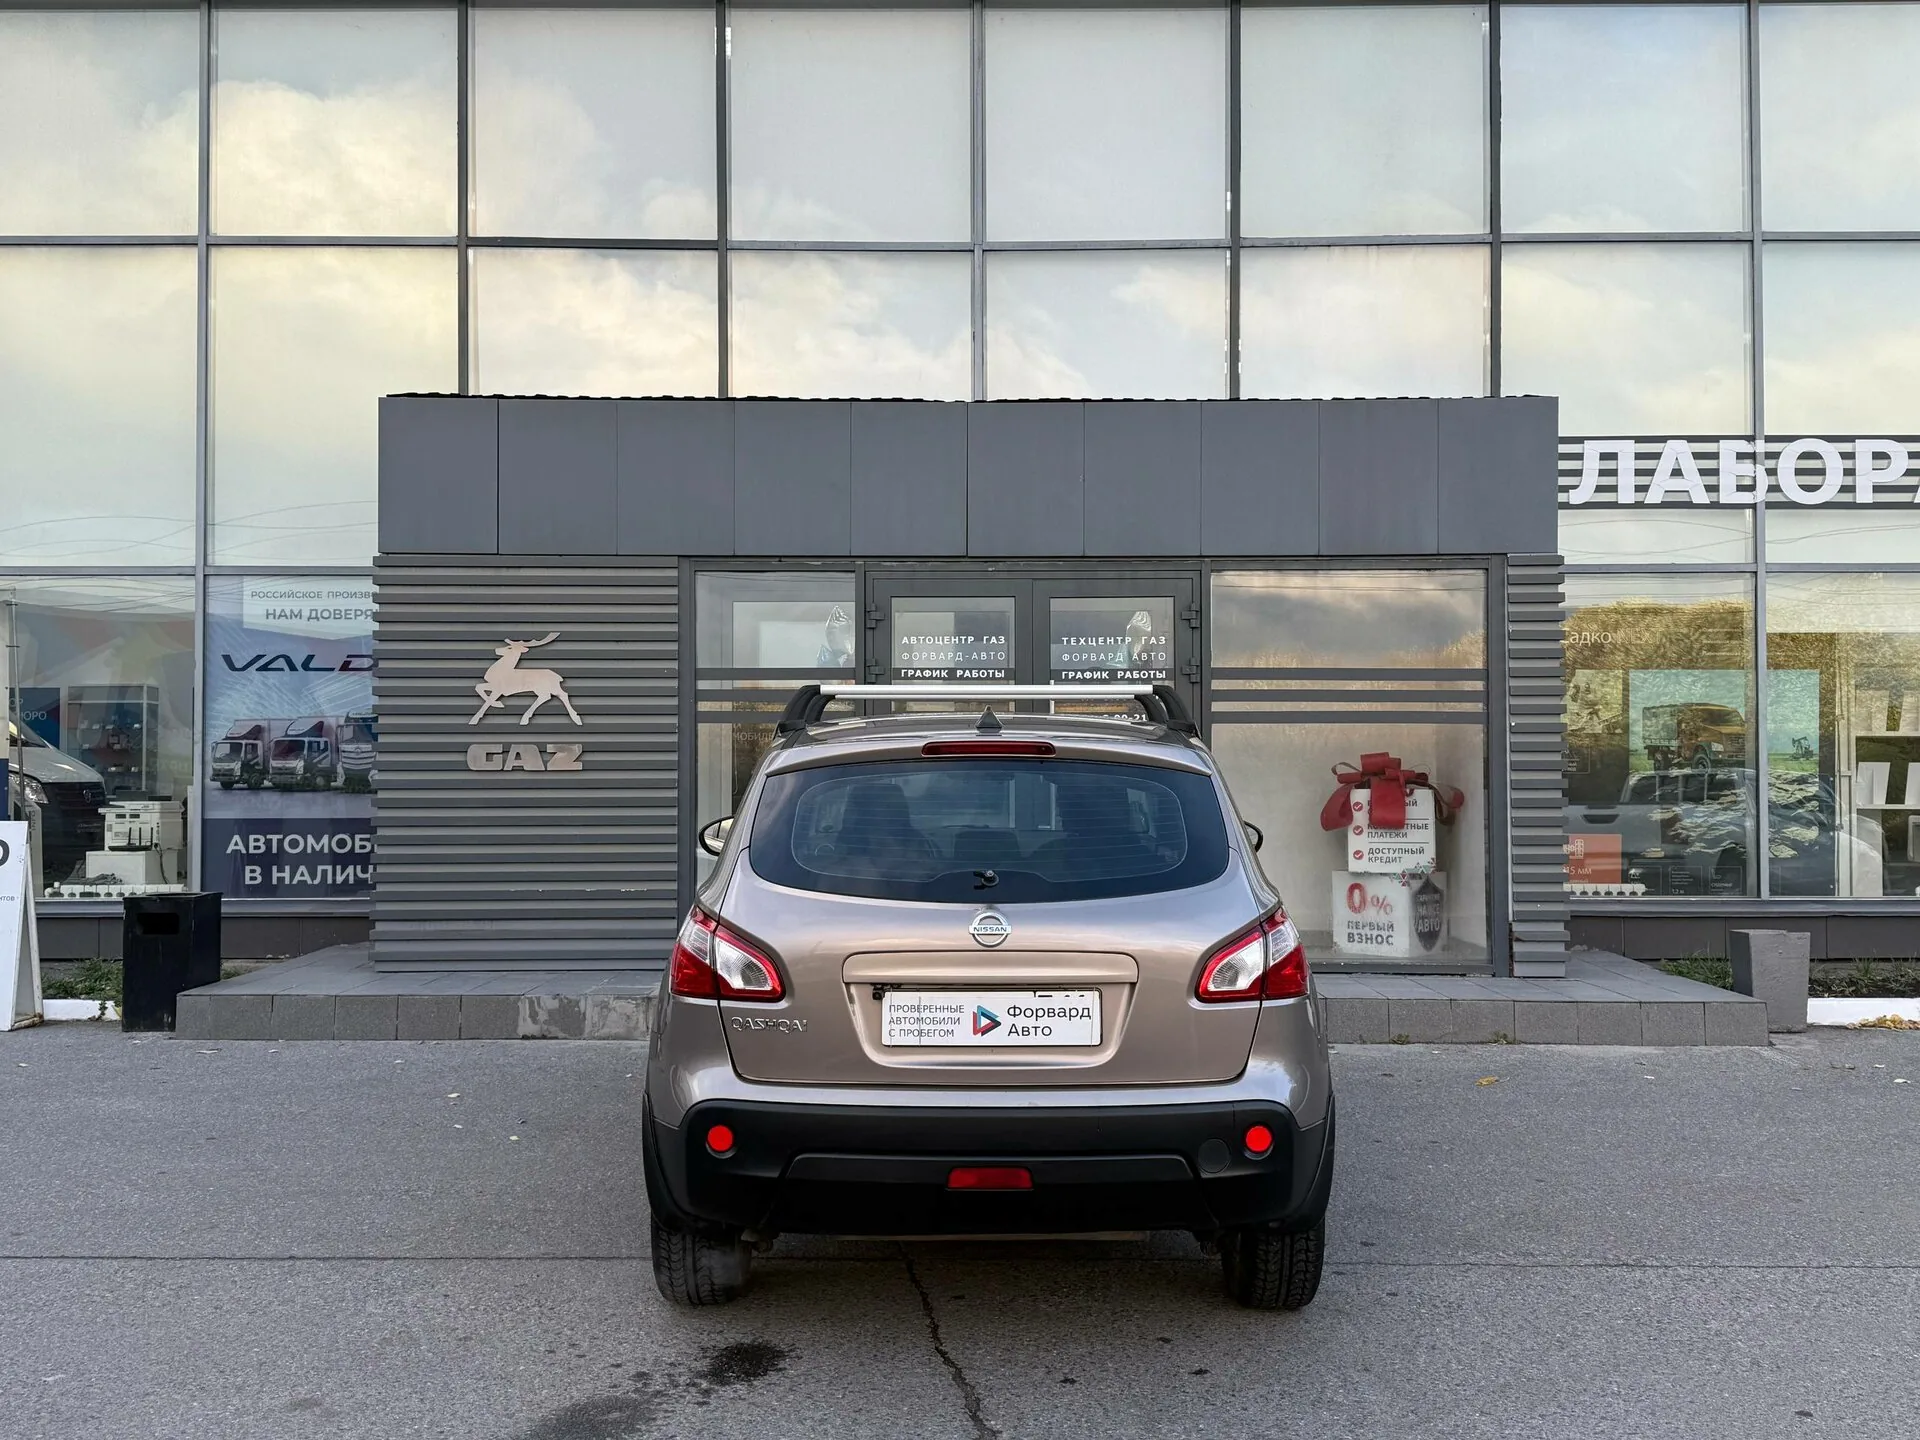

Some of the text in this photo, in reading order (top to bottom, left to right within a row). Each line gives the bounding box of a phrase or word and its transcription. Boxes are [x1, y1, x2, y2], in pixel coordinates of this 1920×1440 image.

[1569, 438, 1920, 505] ЛАБОР
[251, 589, 322, 599] РОССИЙСКОЕ
[265, 608, 378, 622] НАМ ДОВЕРЯ
[901, 636, 1006, 646] АВТОЦЕНТР ГАЗ
[1061, 636, 1166, 647] ТЕХЦЕНТР ГАЗ
[1561, 627, 1612, 647] адко
[901, 651, 1006, 661] ФОРВАРД-АВТО
[1061, 652, 1166, 662] ФОРВАРД АВТО
[901, 669, 1005, 678] ГРАФИК РАБОТЫ
[1061, 670, 1166, 680] ГРАФИК РАБОТЫ
[466, 743, 583, 771] GAZ
[1367, 831, 1408, 839] ПЛАТЕЖИ
[226, 833, 378, 854] АВТОМОБ
[1368, 846, 1425, 855] ДОСТУПНЫЙ
[245, 866, 262, 885] В
[1347, 920, 1395, 932] ПЕРВЫЙ
[1347, 932, 1394, 946] ВЗНОС
[889, 1004, 965, 1014] ПРОВЕРЕННЫЕ
[1006, 1005, 1092, 1021] Форвард
[731, 1016, 808, 1033] QASHQAI
[888, 1016, 961, 1026] АВТОМОБИЛИ
[888, 1028, 954, 1038] С ПРОБЕГОМ
[1007, 1023, 1053, 1037] Авто
